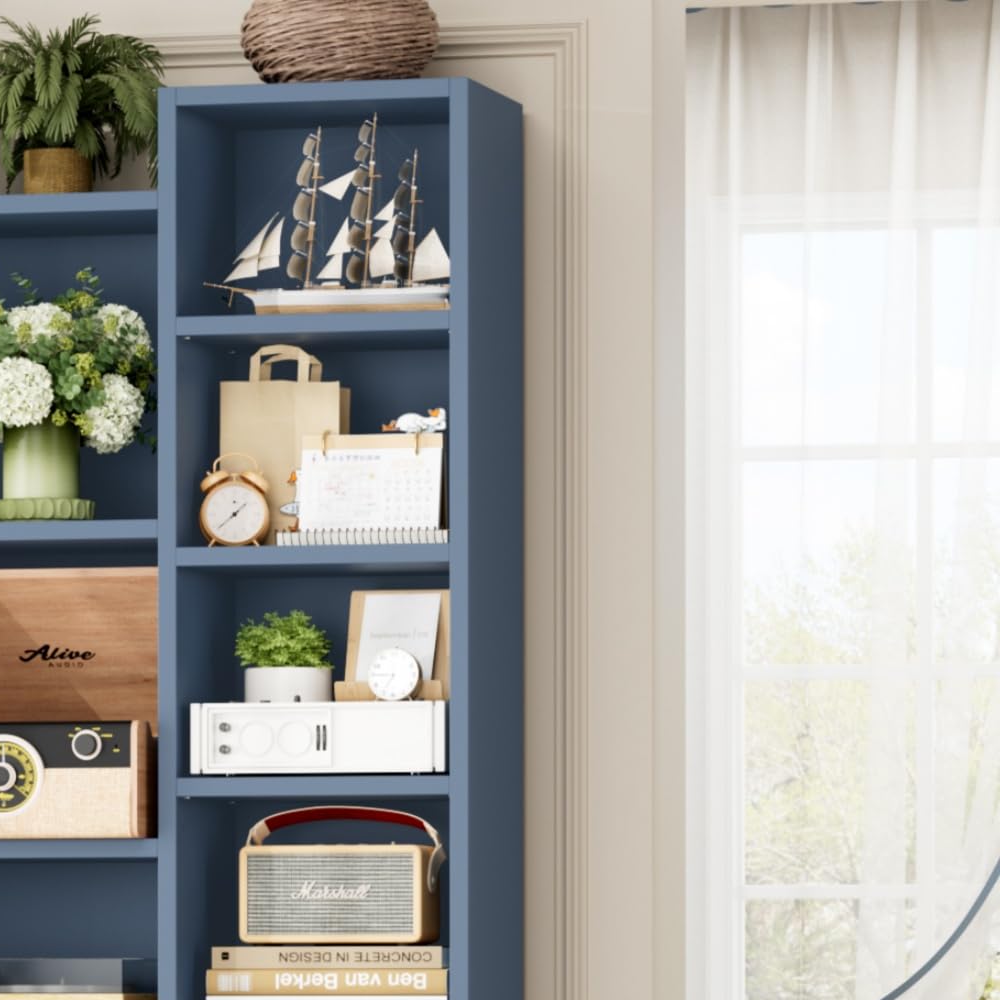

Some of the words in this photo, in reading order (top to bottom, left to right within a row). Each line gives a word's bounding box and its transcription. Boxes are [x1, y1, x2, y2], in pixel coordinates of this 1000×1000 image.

[18, 644, 96, 662] Alive
[290, 880, 372, 900] Marshall
[278, 952, 332, 962] DESIGN
[336, 952, 349, 962] IN
[354, 952, 433, 962] CONCRETE
[275, 972, 338, 990] Berkel
[345, 972, 381, 986] van
[388, 972, 428, 990] Ben
